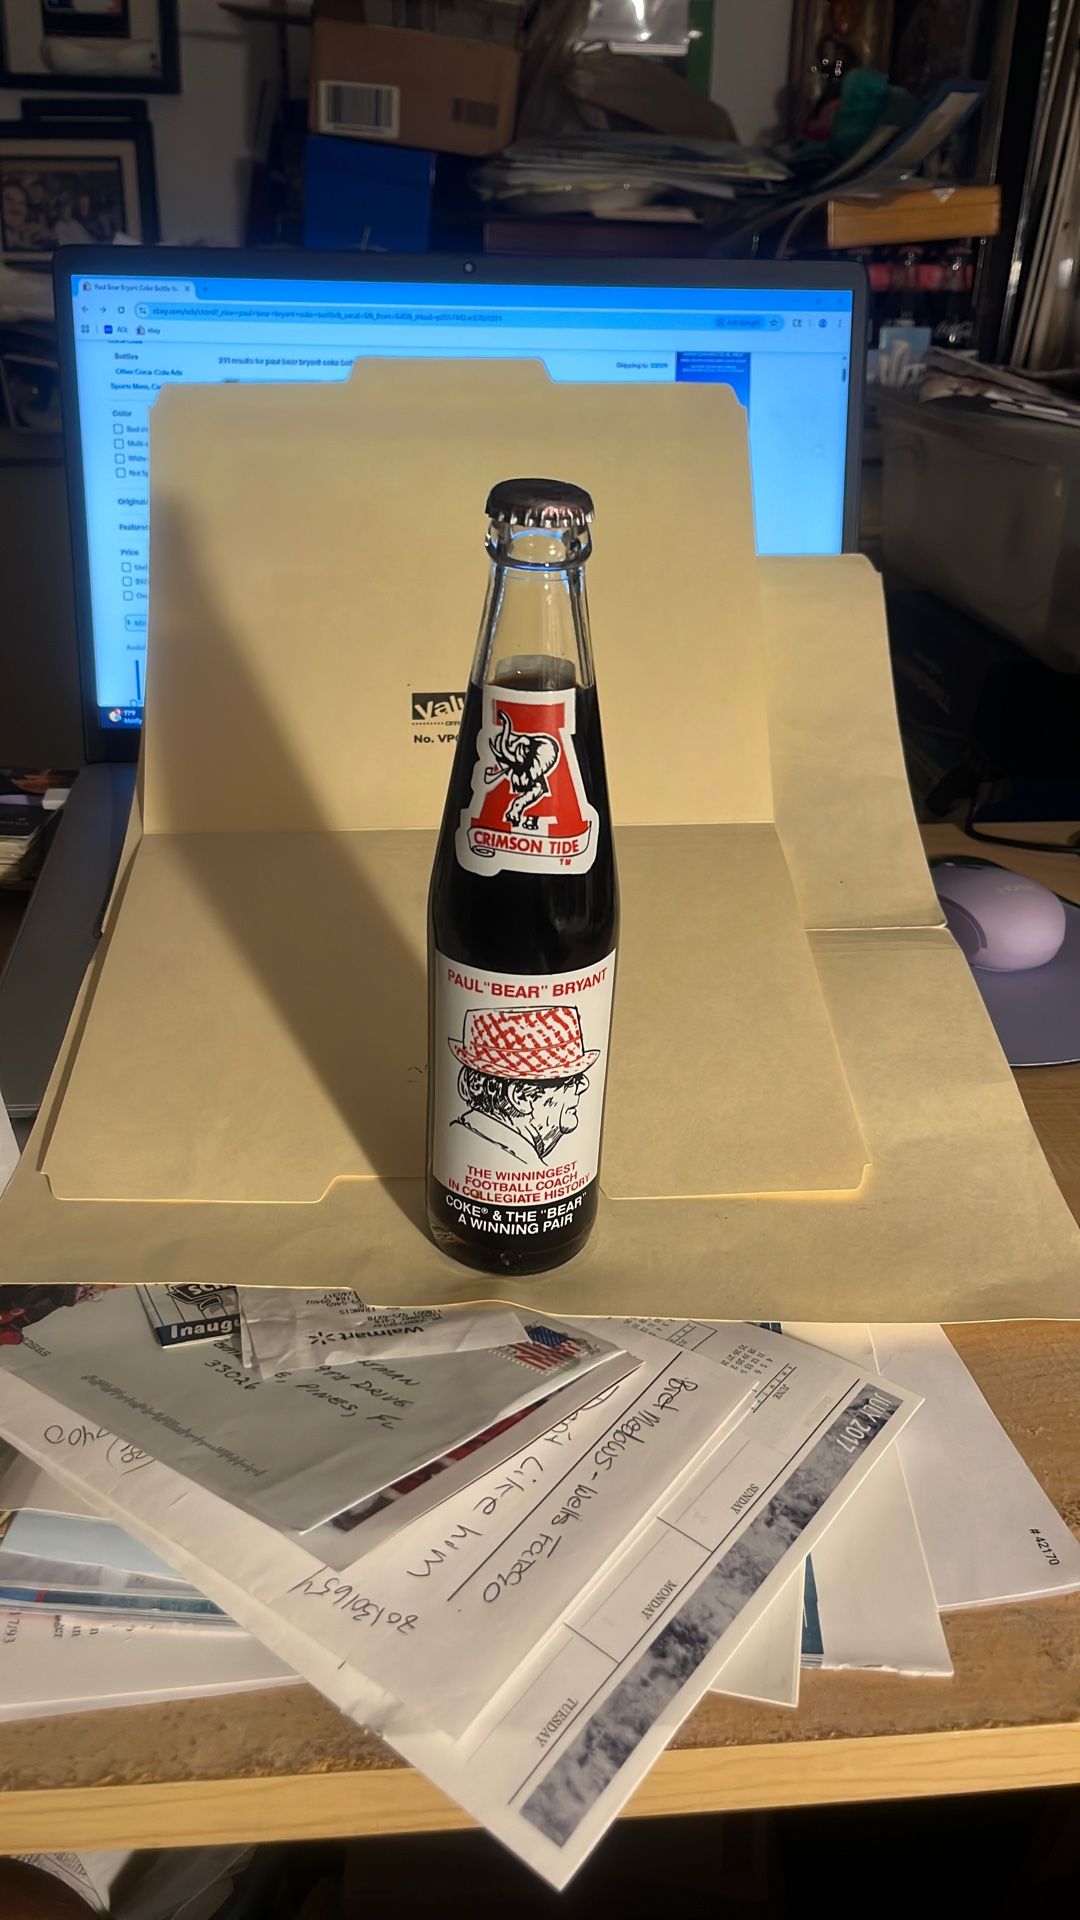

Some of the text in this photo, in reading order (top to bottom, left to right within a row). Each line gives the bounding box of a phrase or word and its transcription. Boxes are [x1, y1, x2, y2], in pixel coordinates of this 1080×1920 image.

[115, 368, 134, 376] Other
[110, 383, 132, 392] Sports
[414, 734, 435, 744] No.
[474, 830, 580, 855] CRIMSON TIDE
[448, 968, 484, 994] PAUL
[552, 967, 608, 997] BRYANT
[464, 1171, 578, 1192] FOOTBALL COACH
[467, 1160, 578, 1182] THE WINNINGEST
[448, 1172, 591, 1204] IN COLLEGIATE HISTORY
[492, 1210, 502, 1222] &
[506, 1210, 537, 1223] THE
[540, 1192, 588, 1220] "BEAR"
[458, 1213, 574, 1236] A WINNING PAIR
[338, 1326, 424, 1340] Walmart
[836, 1392, 894, 1454] JULY 2017
[730, 1483, 760, 1514] SUNDAY
[1034, 1536, 1060, 1566] 42170
[640, 1580, 678, 1620] MONDAY
[534, 1697, 579, 1748] TUESDAY
